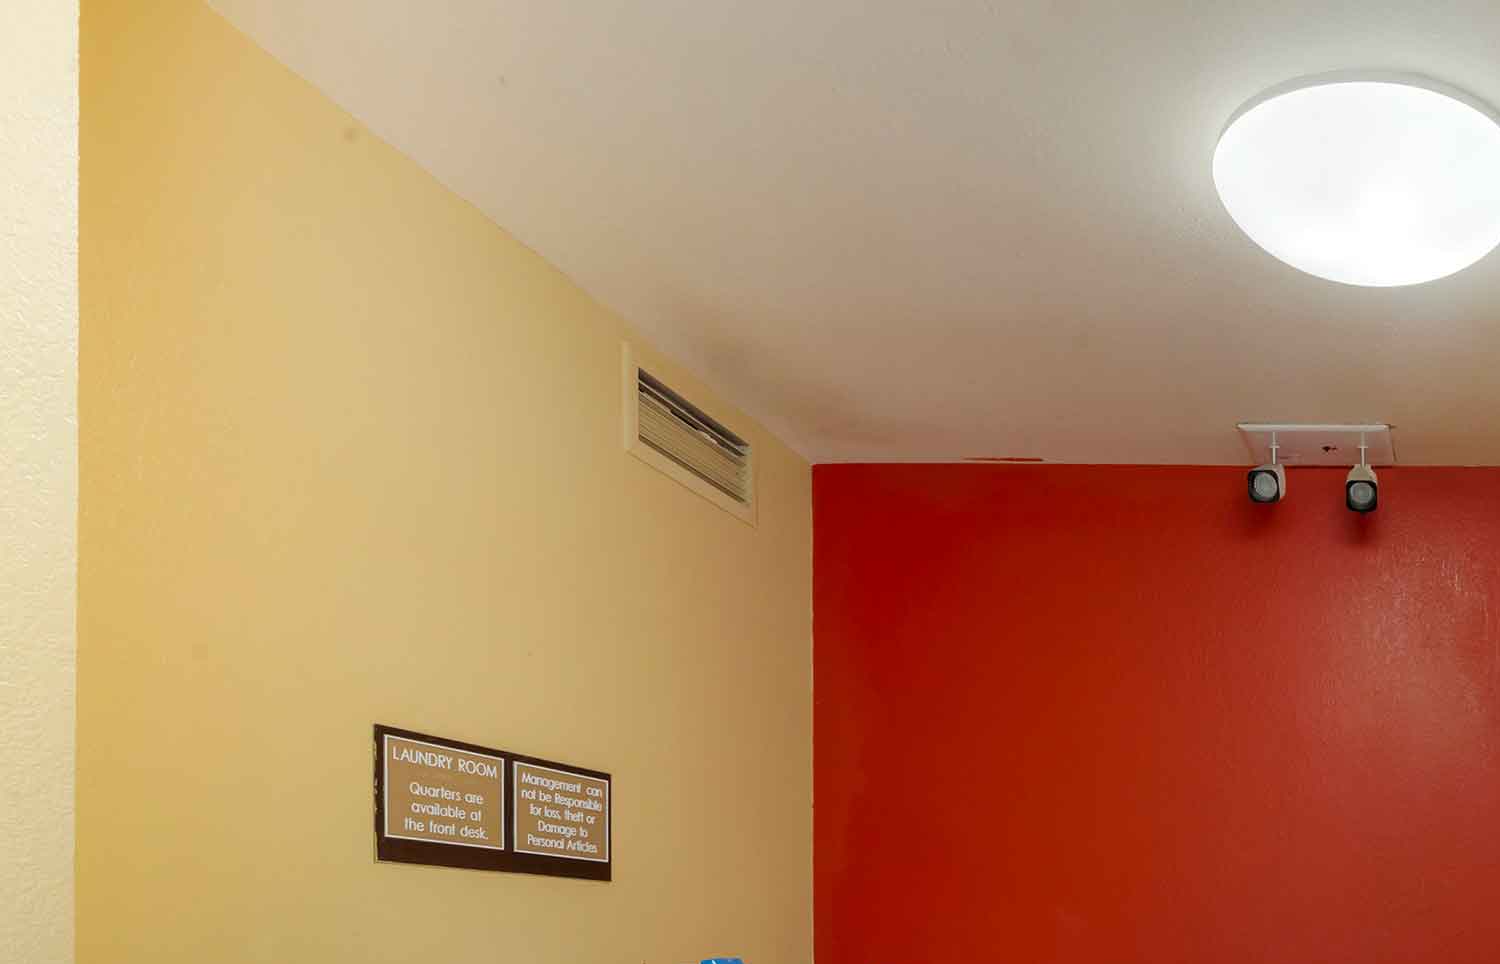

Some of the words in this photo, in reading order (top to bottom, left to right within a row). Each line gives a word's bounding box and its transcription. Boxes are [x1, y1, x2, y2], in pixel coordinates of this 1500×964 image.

[392, 746, 453, 769] LAUNDRY
[458, 758, 497, 778] ROOM
[409, 782, 461, 801] Quarters
[464, 793, 484, 805] are
[521, 772, 581, 793] Management
[586, 787, 602, 797] can
[411, 801, 466, 819] available
[470, 810, 482, 821] at
[521, 789, 536, 800] not
[539, 790, 552, 802] be
[554, 793, 602, 811] Responsible
[529, 803, 542, 816] for
[564, 809, 584, 823] theft
[586, 815, 596, 824] or
[404, 816, 424, 832] the
[429, 820, 456, 836] front
[460, 825, 488, 840] desk.
[537, 820, 576, 838] Damage
[579, 826, 588, 838] to
[528, 834, 565, 849] Personal
